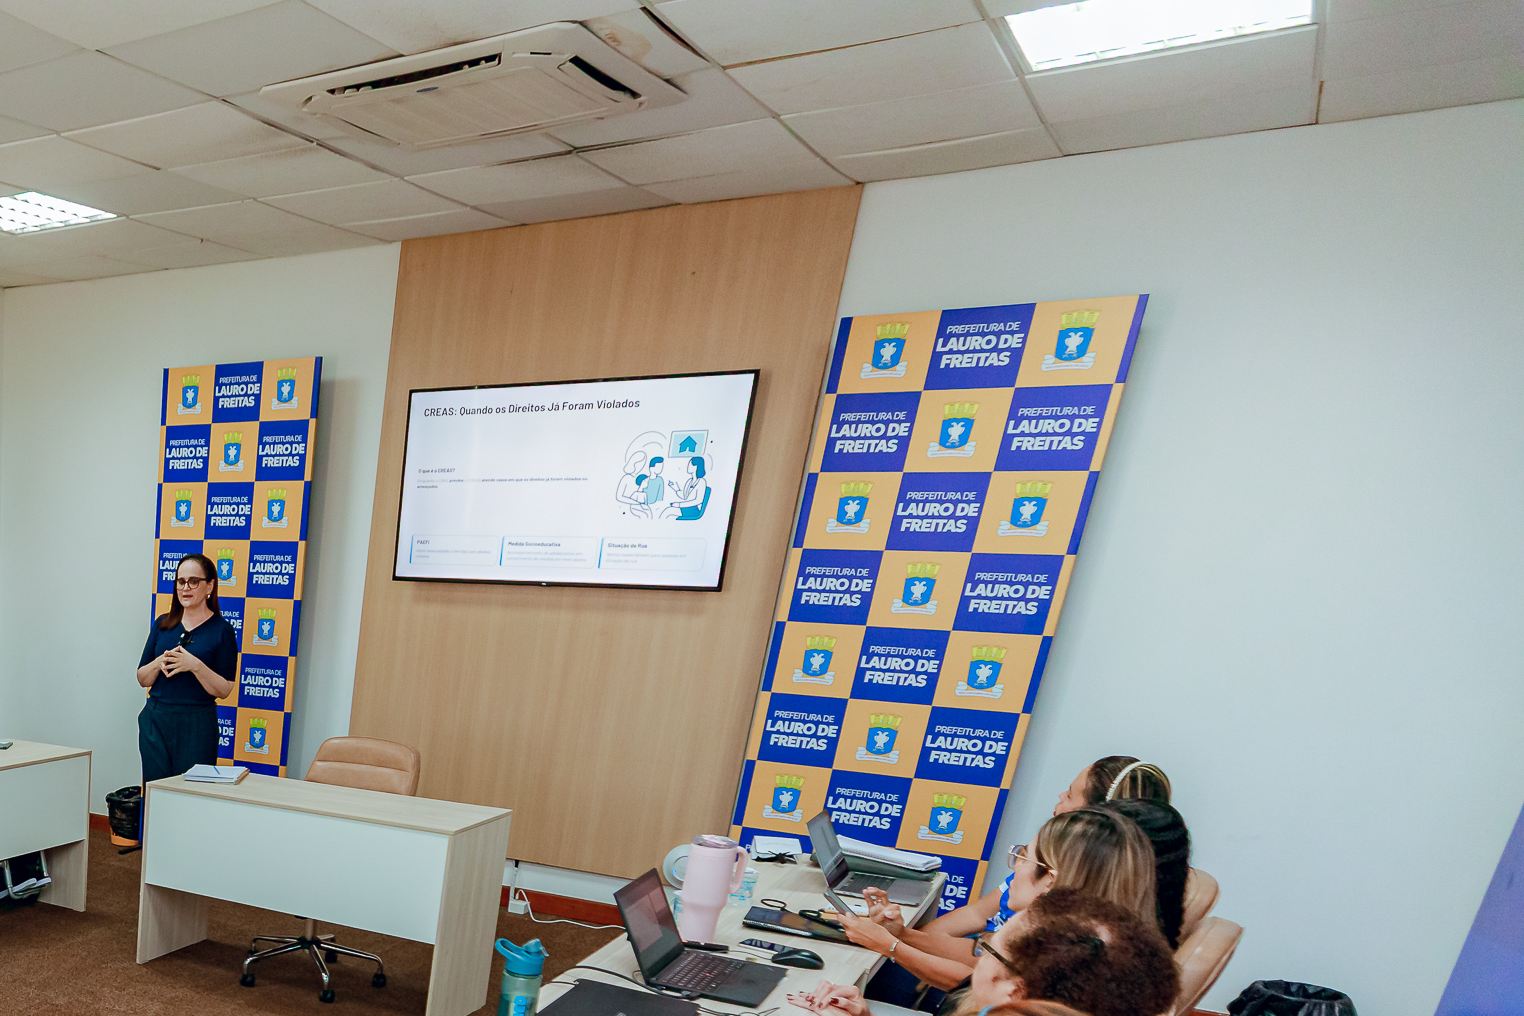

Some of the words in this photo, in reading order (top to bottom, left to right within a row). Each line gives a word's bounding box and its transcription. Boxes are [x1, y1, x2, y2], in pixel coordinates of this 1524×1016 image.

[947, 323, 1004, 334] PREFEITURA
[1005, 322, 1020, 331] DE
[936, 335, 995, 352] LAURO
[998, 333, 1024, 349] DE
[939, 351, 1011, 369] FREITAS
[219, 376, 250, 384] PREFEITURA
[216, 384, 246, 396] LAURO
[247, 383, 260, 395] DE
[218, 396, 255, 408] FREITAS
[424, 407, 457, 417] CREAS:
[460, 406, 493, 416] Quando
[496, 406, 506, 414] os
[509, 403, 545, 413] Direitos
[548, 402, 560, 411] Já
[562, 401, 594, 410] Foram
[596, 399, 640, 410] Violados
[840, 413, 893, 421] PREFEITURA
[892, 412, 906, 420] DE
[1018, 407, 1079, 417] PREFEITURA
[1079, 406, 1095, 415] DE
[830, 424, 885, 438] LAURO
[887, 423, 910, 436] DE
[1007, 420, 1070, 435] LAURO
[1072, 418, 1099, 432] DE
[259, 445, 291, 455] LAURO
[293, 443, 305, 454] DE
[834, 439, 898, 454] FREITAS
[1011, 436, 1085, 451] FREITAS
[166, 447, 195, 458] LAURO
[196, 447, 208, 457] DE
[169, 459, 203, 470] FREITAS
[262, 456, 299, 468] FREITAS
[906, 491, 961, 501] PREFEITURA
[961, 491, 975, 500] DE
[207, 505, 238, 515] LAURO
[239, 505, 251, 514] DE
[897, 502, 954, 516] LAURO
[956, 502, 980, 516] DE
[211, 516, 245, 527] FREITAS
[900, 518, 967, 533] FREITAS
[250, 563, 281, 573] LAURO
[282, 564, 294, 573] DE
[805, 566, 856, 577] PREFEITURA
[855, 568, 869, 576] DE
[253, 575, 289, 585] FREITAS
[974, 572, 1032, 582] PREFEITURA
[1031, 574, 1048, 583] DE
[797, 577, 847, 591] LAURO
[849, 578, 872, 592] DE
[965, 583, 1023, 598] LAURO
[1026, 585, 1052, 599] DE
[801, 593, 862, 607] FREITAS
[968, 600, 1038, 615] FREITAS
[231, 619, 241, 629] DE
[869, 646, 922, 656] PREFEITURA
[922, 648, 935, 657] DE
[860, 655, 914, 670] LAURO
[916, 658, 939, 673] DE
[241, 675, 271, 686] LAURO
[272, 678, 284, 687] DE
[864, 670, 928, 687] FREITAS
[244, 686, 279, 698] FREITAS
[774, 710, 823, 721] PREFEITURA
[823, 713, 835, 722] DE
[223, 727, 234, 736] DE
[766, 720, 817, 735] LAURO
[819, 724, 838, 738] DE
[935, 726, 989, 738] PREFEITURA
[988, 729, 1004, 739] DE
[769, 733, 828, 751] FREITAS
[925, 735, 983, 752] LAURO
[985, 740, 1008, 755] DE
[929, 750, 995, 769] FREITAS
[836, 788, 887, 800] PREFEITURA
[886, 791, 899, 802] DE
[828, 796, 878, 813] LAURO
[880, 802, 903, 817] DE
[830, 811, 891, 830] FREITAS
[952, 876, 964, 884] DE
[945, 884, 968, 898] DE
